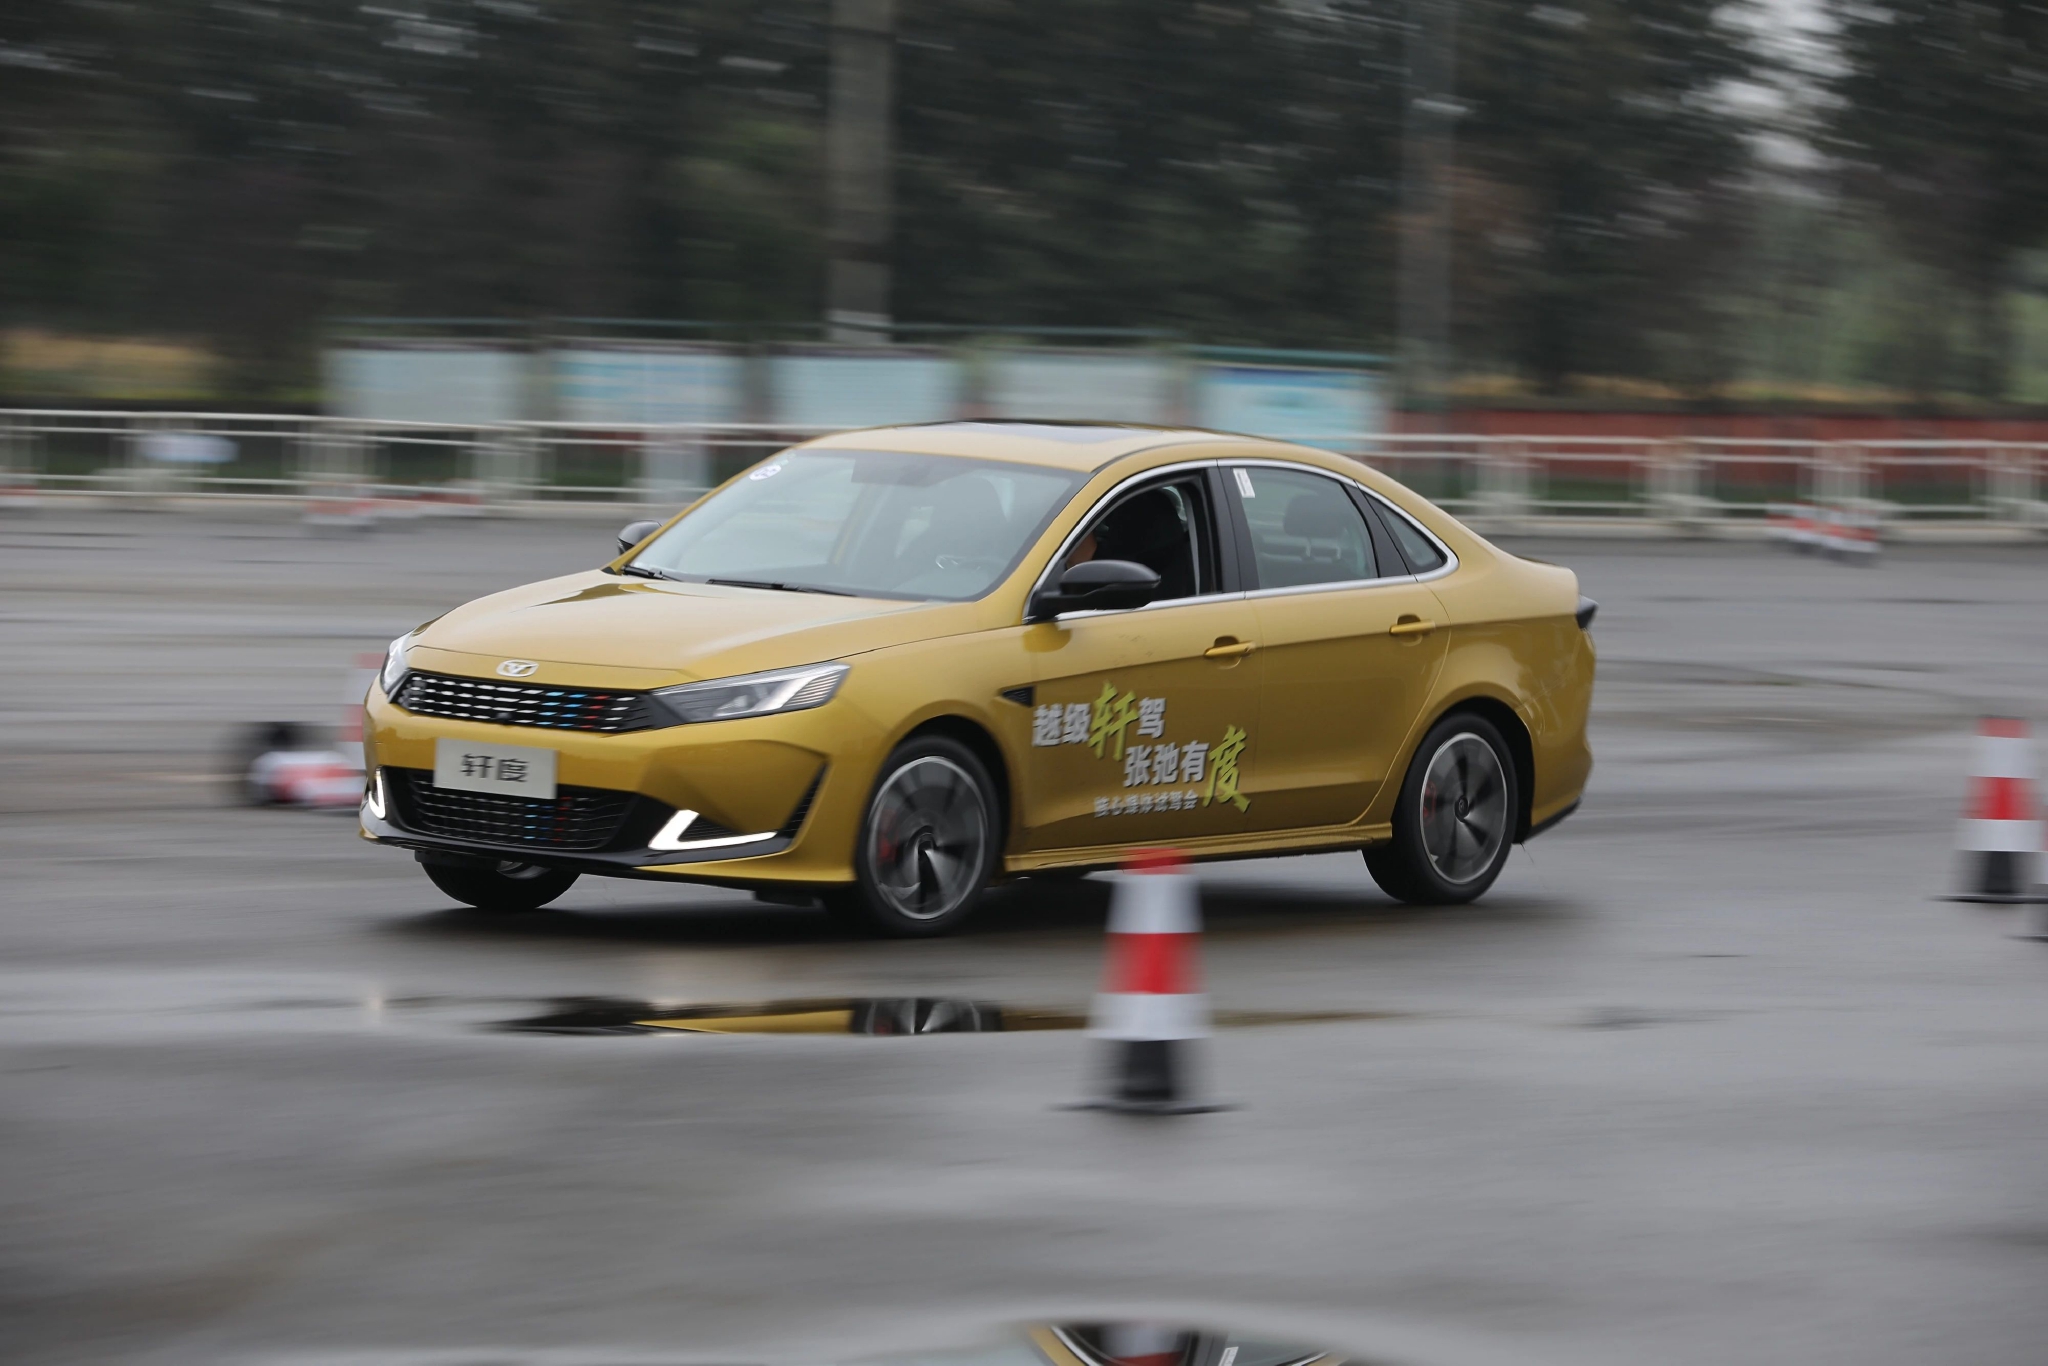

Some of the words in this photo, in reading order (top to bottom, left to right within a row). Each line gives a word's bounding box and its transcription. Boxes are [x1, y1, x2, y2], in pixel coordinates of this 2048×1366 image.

[1032, 679, 1166, 762] 越级轩驾
[460, 753, 530, 783] 轩度
[1123, 724, 1250, 813] 张弛有度
